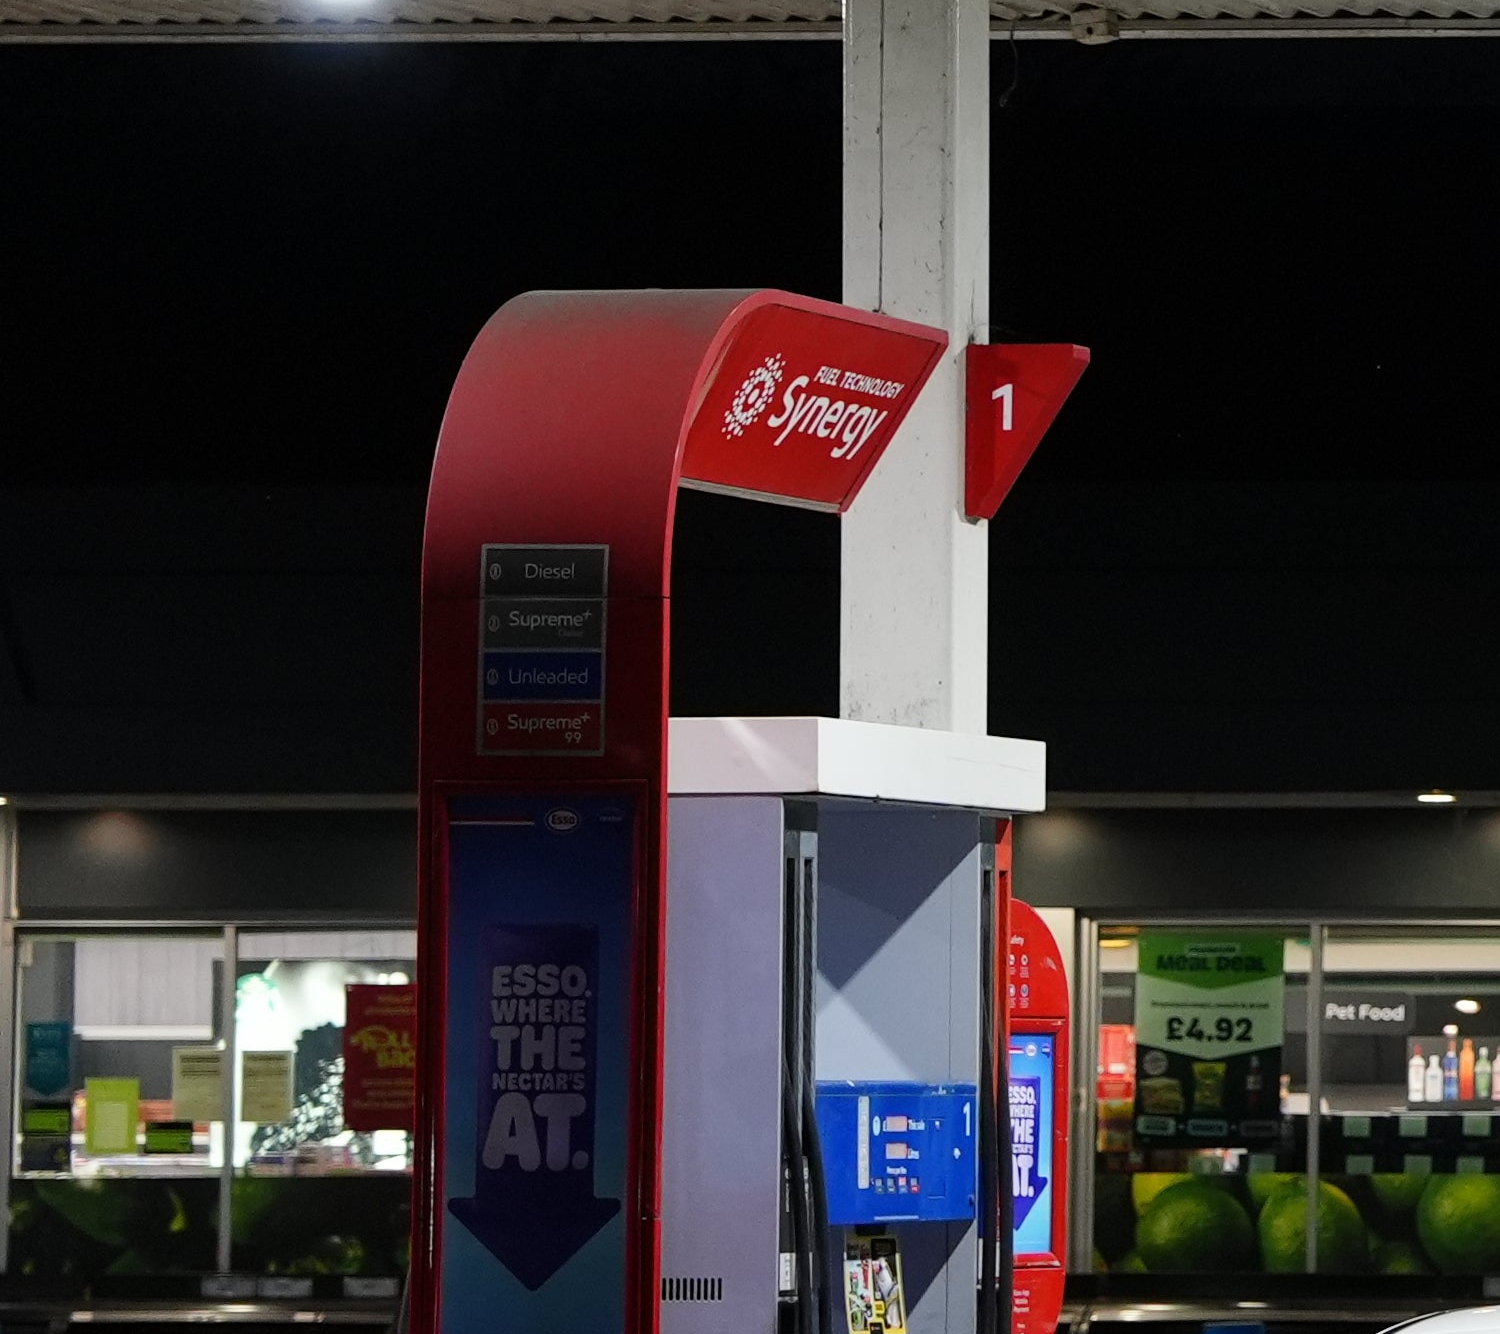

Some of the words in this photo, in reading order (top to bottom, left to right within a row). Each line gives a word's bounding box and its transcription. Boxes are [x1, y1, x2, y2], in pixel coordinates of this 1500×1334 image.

[812, 365, 842, 387] FUEL
[838, 370, 906, 400] TECHNOLOGY
[766, 374, 889, 461] Synergy
[991, 381, 1014, 431] 1
[524, 562, 576, 580] Diesel
[508, 667, 590, 685] Unleaded
[564, 731, 582, 744] 99
[490, 998, 587, 1025] WHERE
[1325, 1002, 1356, 1021] Pet
[1358, 1003, 1406, 1022] Food
[1166, 1017, 1253, 1042] £4.92
[489, 1024, 587, 1071] THE
[492, 1072, 586, 1092] NECTAR'S
[481, 1091, 590, 1173] AT.
[962, 1100, 971, 1137] 1
